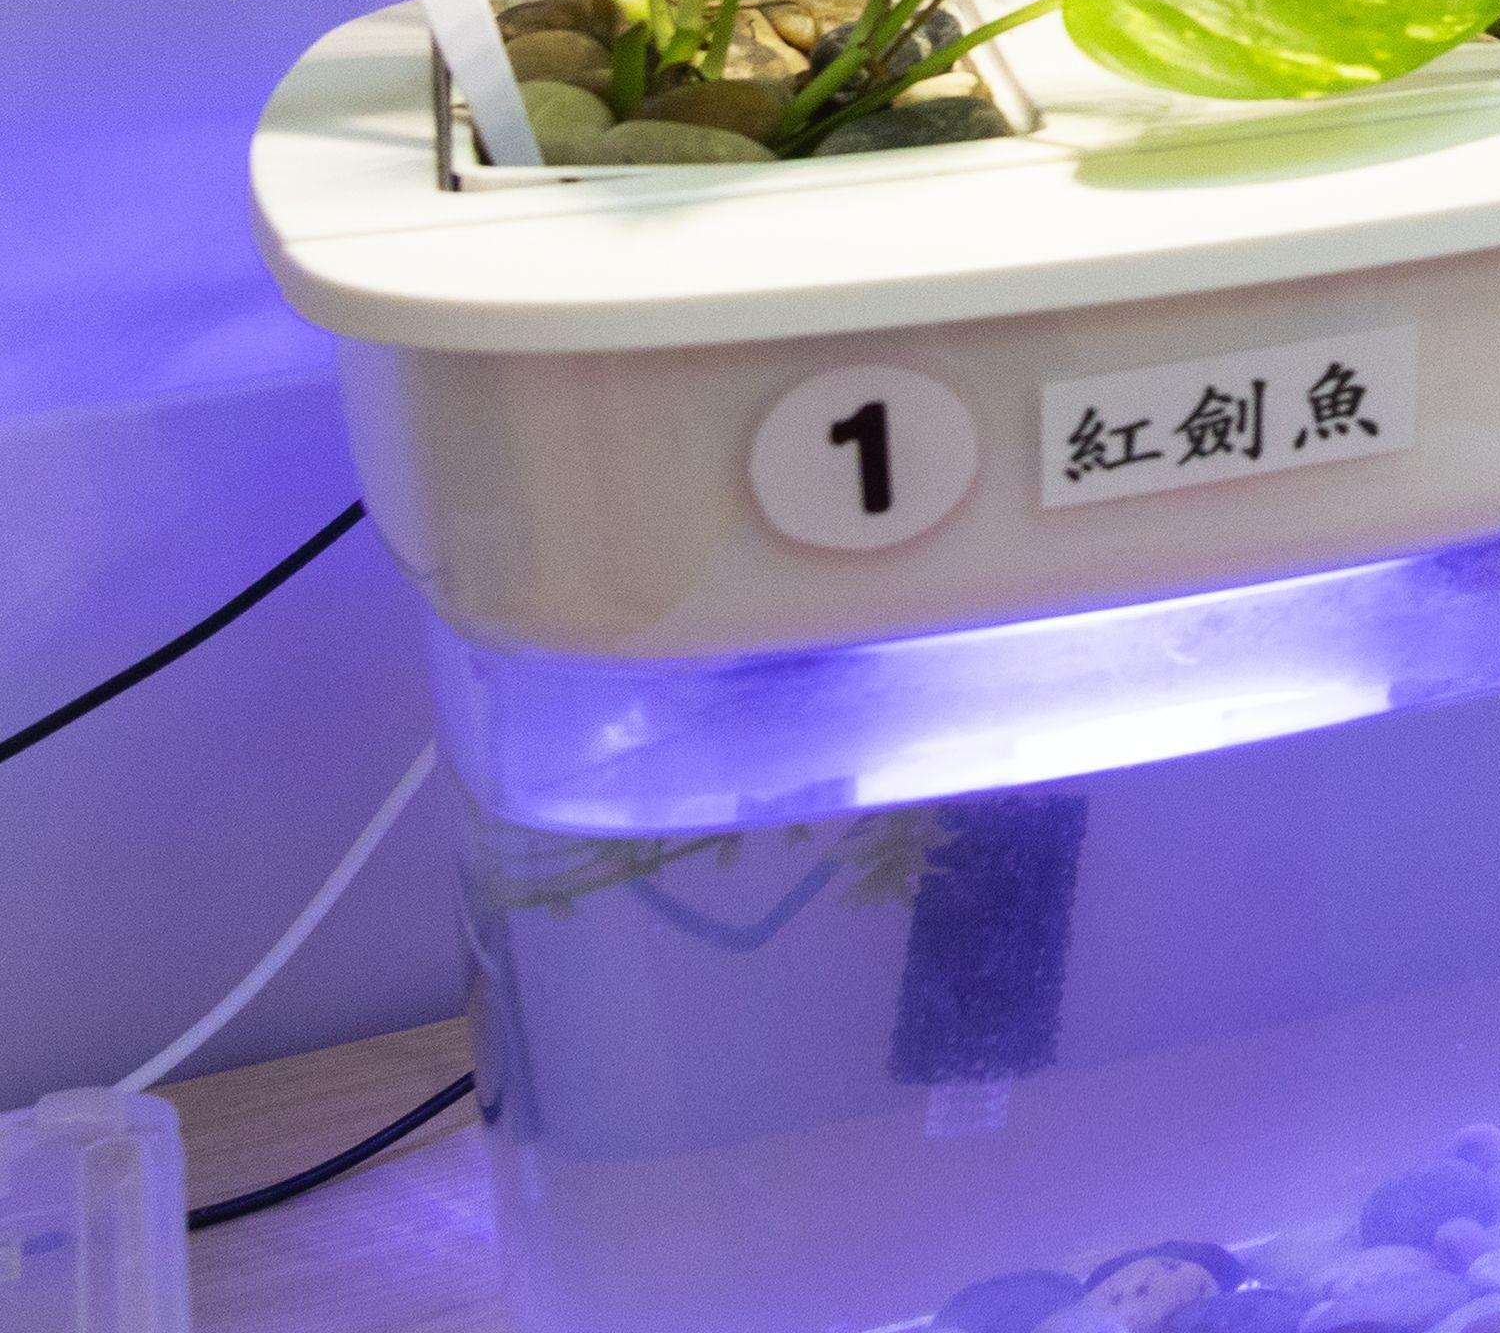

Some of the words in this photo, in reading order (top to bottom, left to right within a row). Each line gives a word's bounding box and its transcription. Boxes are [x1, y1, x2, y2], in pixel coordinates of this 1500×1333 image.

[828, 399, 892, 514] 1
[1063, 359, 1380, 483] 紅劍魚
